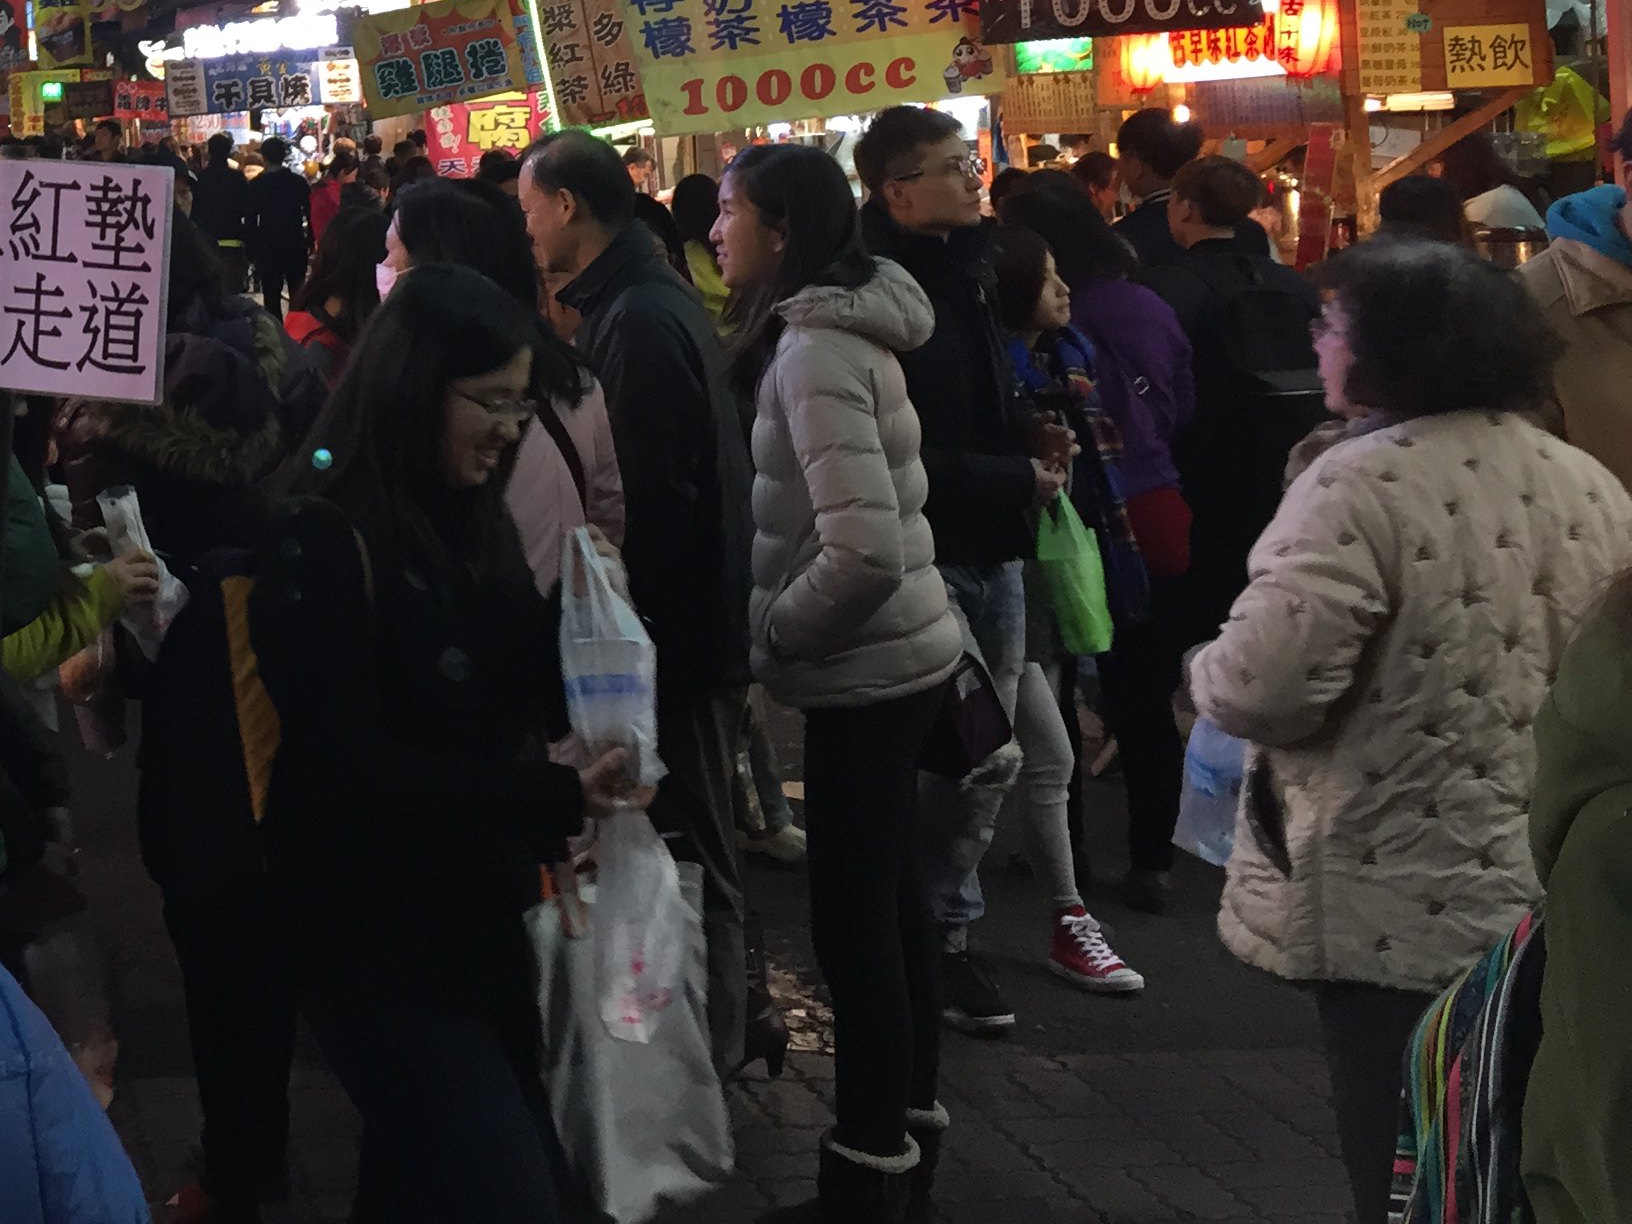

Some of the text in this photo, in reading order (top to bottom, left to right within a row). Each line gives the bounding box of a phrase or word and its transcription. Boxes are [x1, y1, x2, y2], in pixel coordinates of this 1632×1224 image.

[375, 38, 508, 100] 雞腿捲
[1448, 34, 1529, 74] 熱飲
[213, 76, 314, 110] 干貝燒
[680, 56, 917, 116] 1000cc
